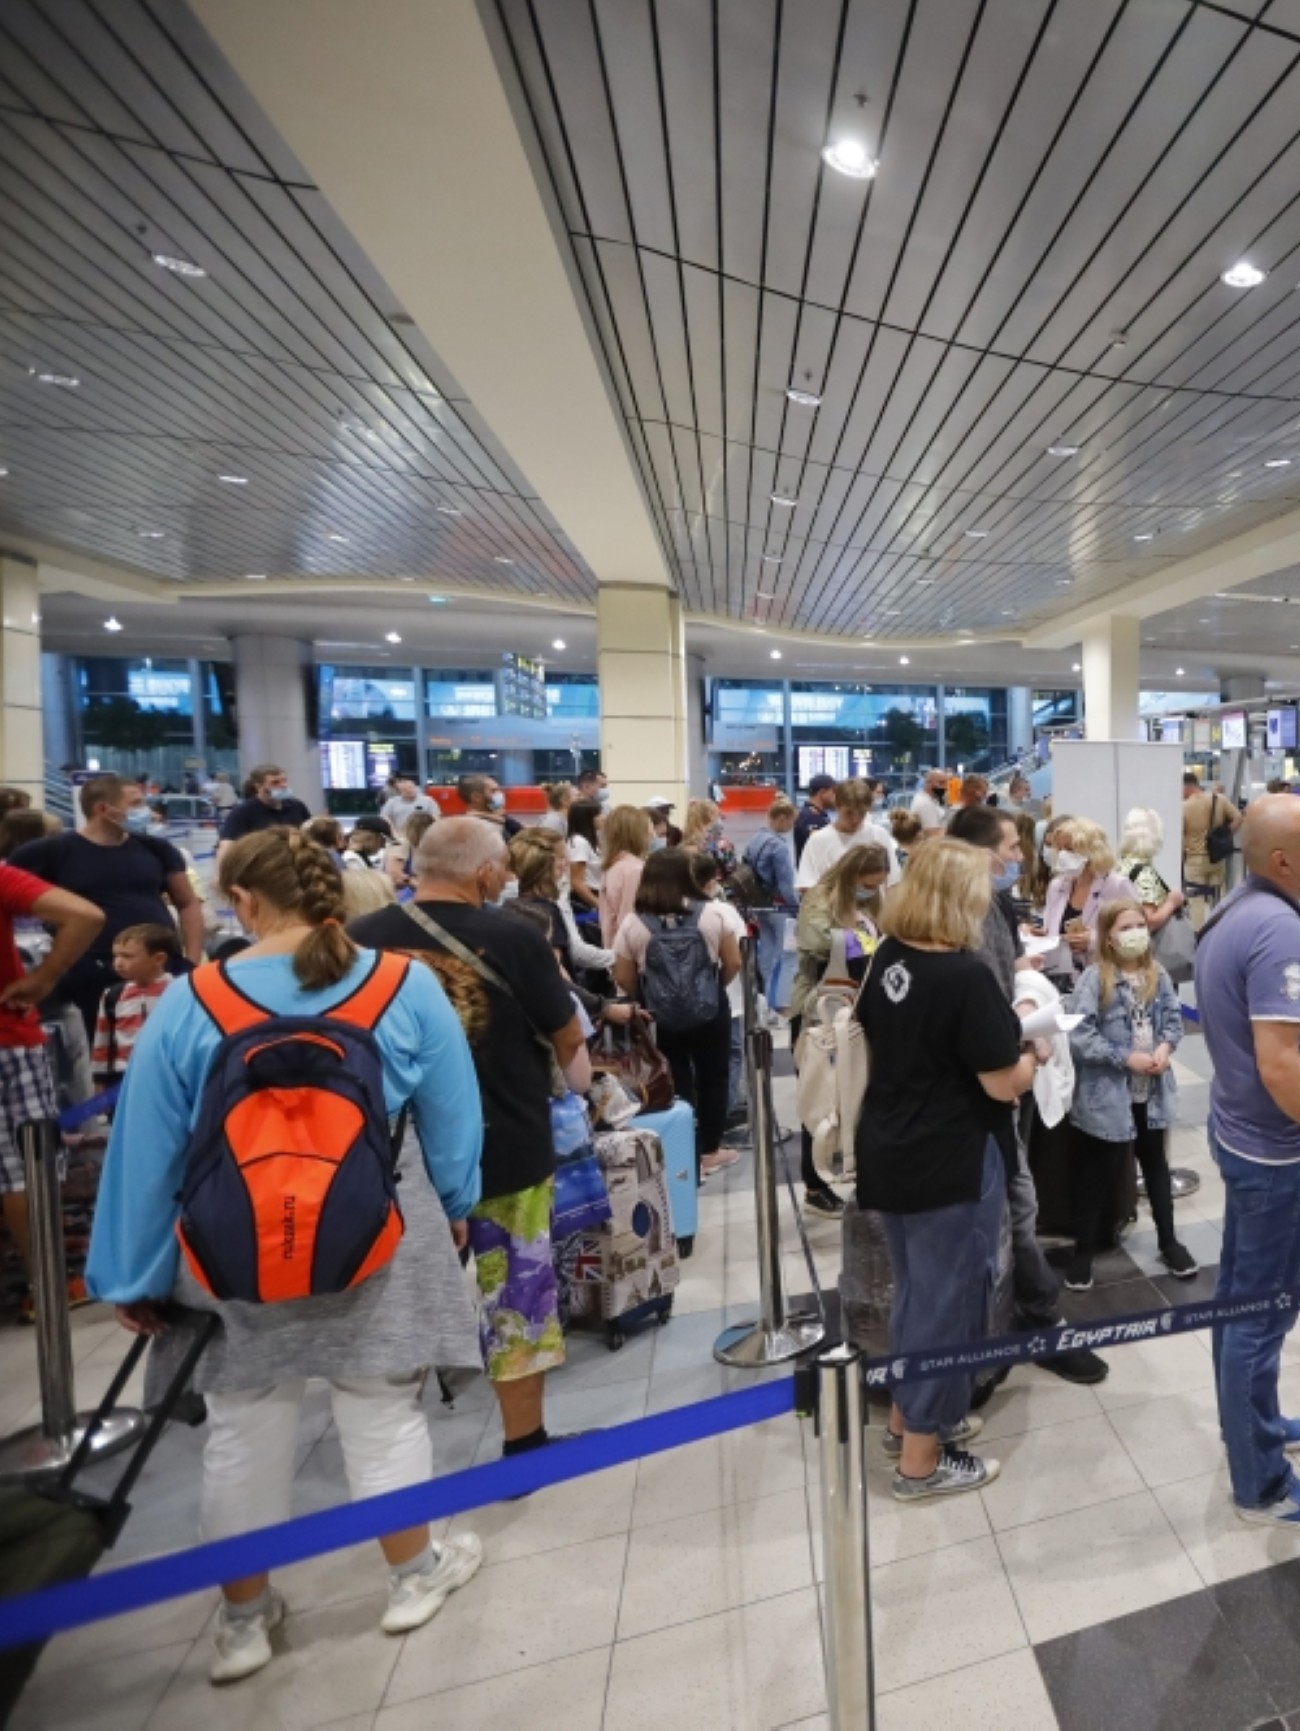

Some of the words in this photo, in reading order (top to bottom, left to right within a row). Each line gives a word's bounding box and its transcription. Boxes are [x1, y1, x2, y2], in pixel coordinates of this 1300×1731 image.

[920, 1355, 953, 1372] STAR
[957, 1344, 1022, 1364] ALLIANCE
[1056, 1318, 1158, 1350] EGYPTAIR
[1184, 1310, 1213, 1325] STAR
[1215, 1301, 1271, 1319] ALLIANCE
